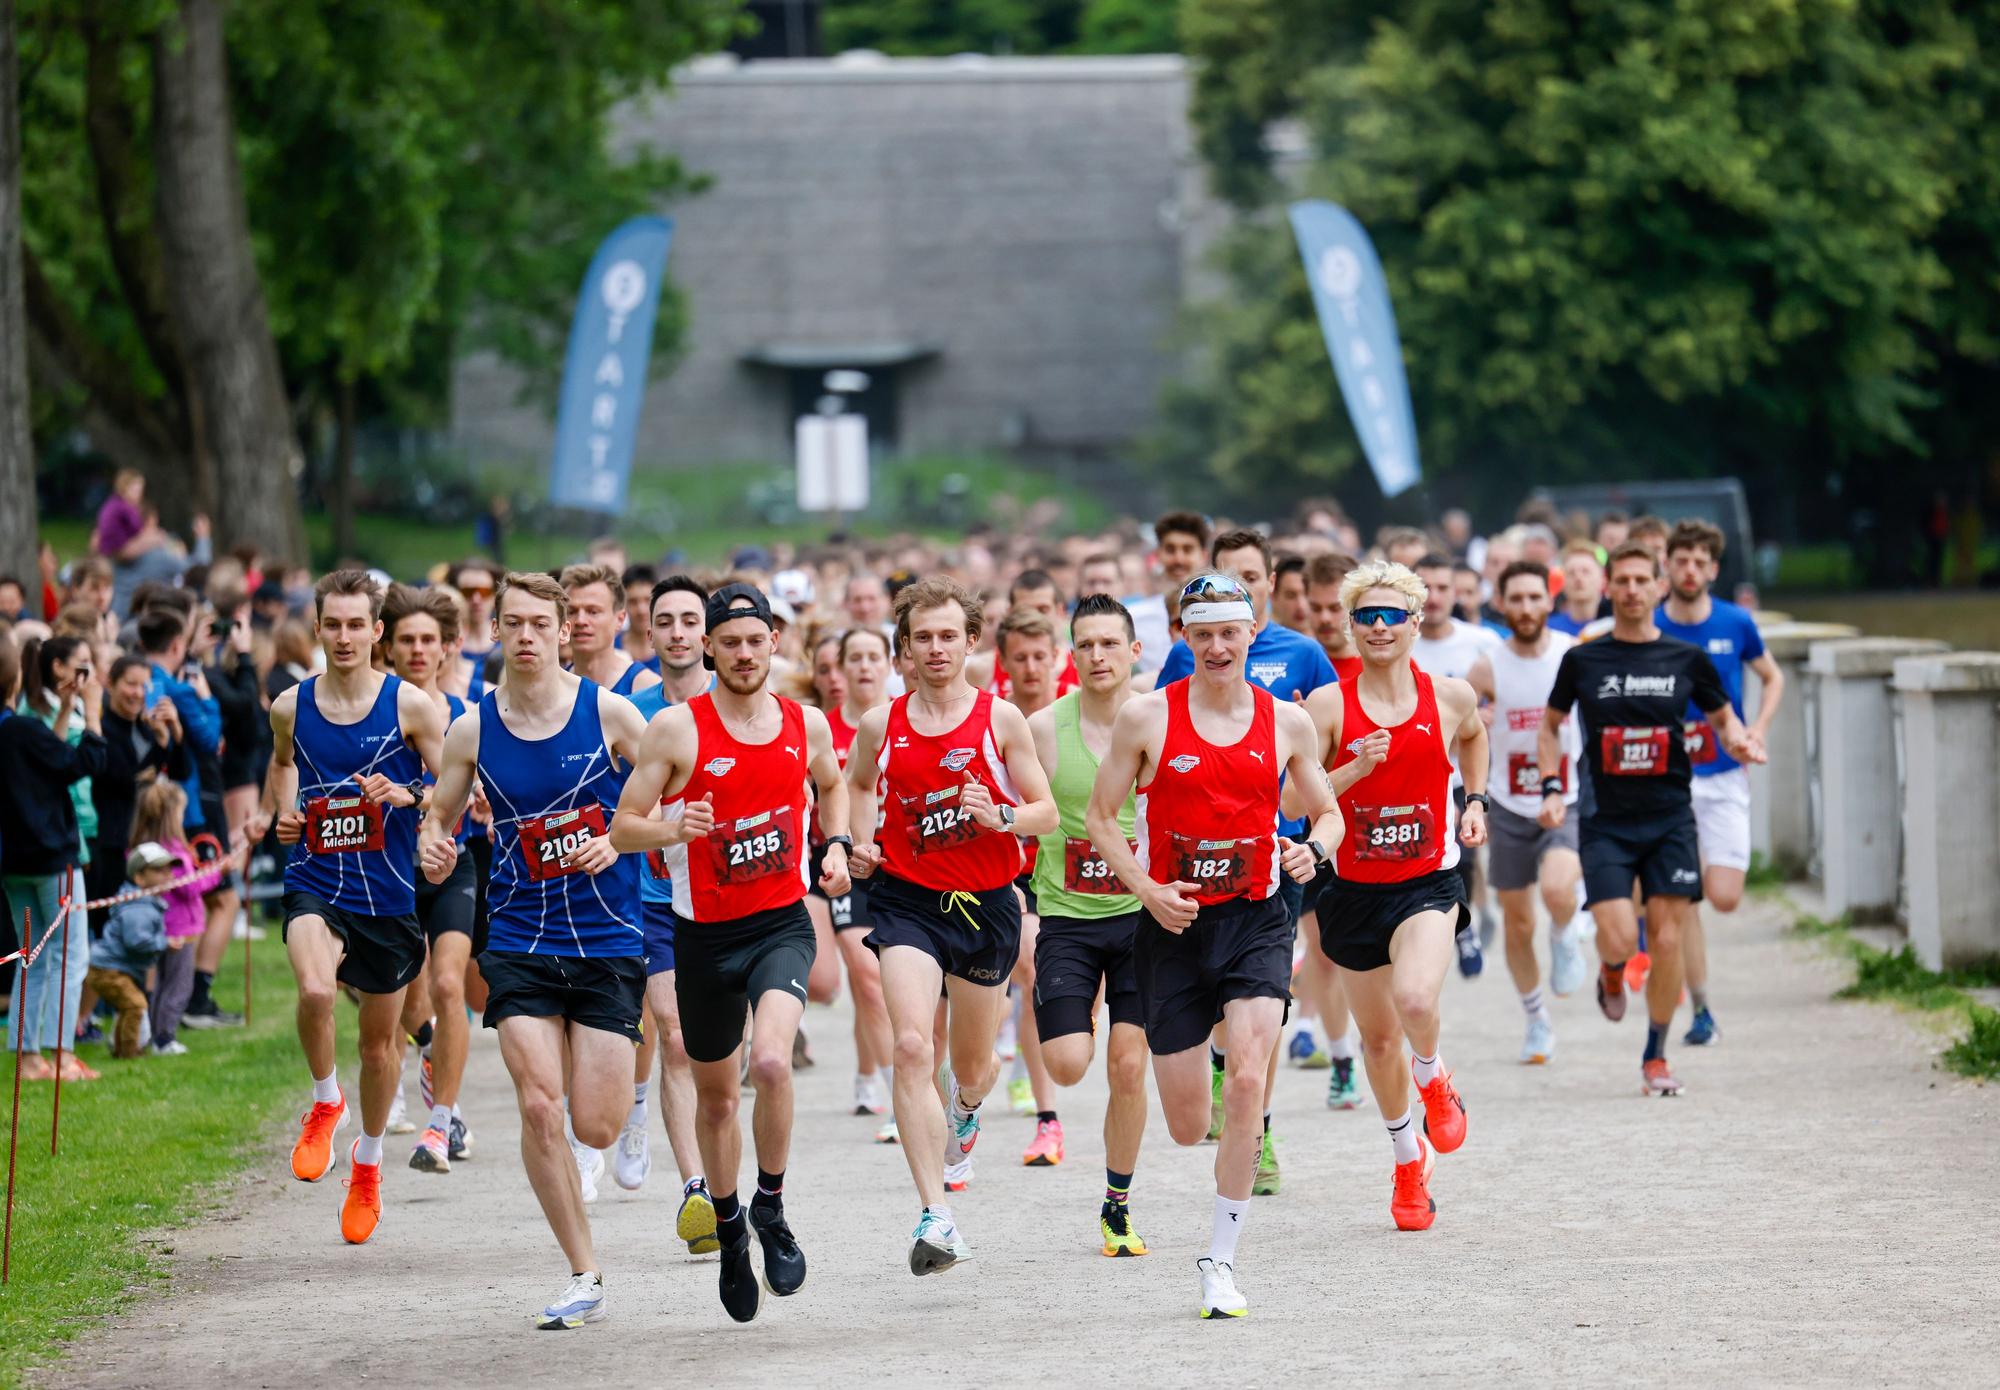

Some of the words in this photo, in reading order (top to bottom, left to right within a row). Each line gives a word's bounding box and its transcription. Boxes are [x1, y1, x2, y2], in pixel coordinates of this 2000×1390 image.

[567, 754, 582, 762] SPORT
[1623, 743, 1650, 761] 121
[321, 815, 364, 838] 2101
[921, 806, 971, 836] 2124
[323, 835, 366, 849] Michael
[540, 827, 591, 862] 2105
[1370, 823, 1420, 845] 3381
[729, 831, 780, 865] 2135
[1192, 858, 1231, 879] 182
[968, 966, 1001, 980] HOKA
